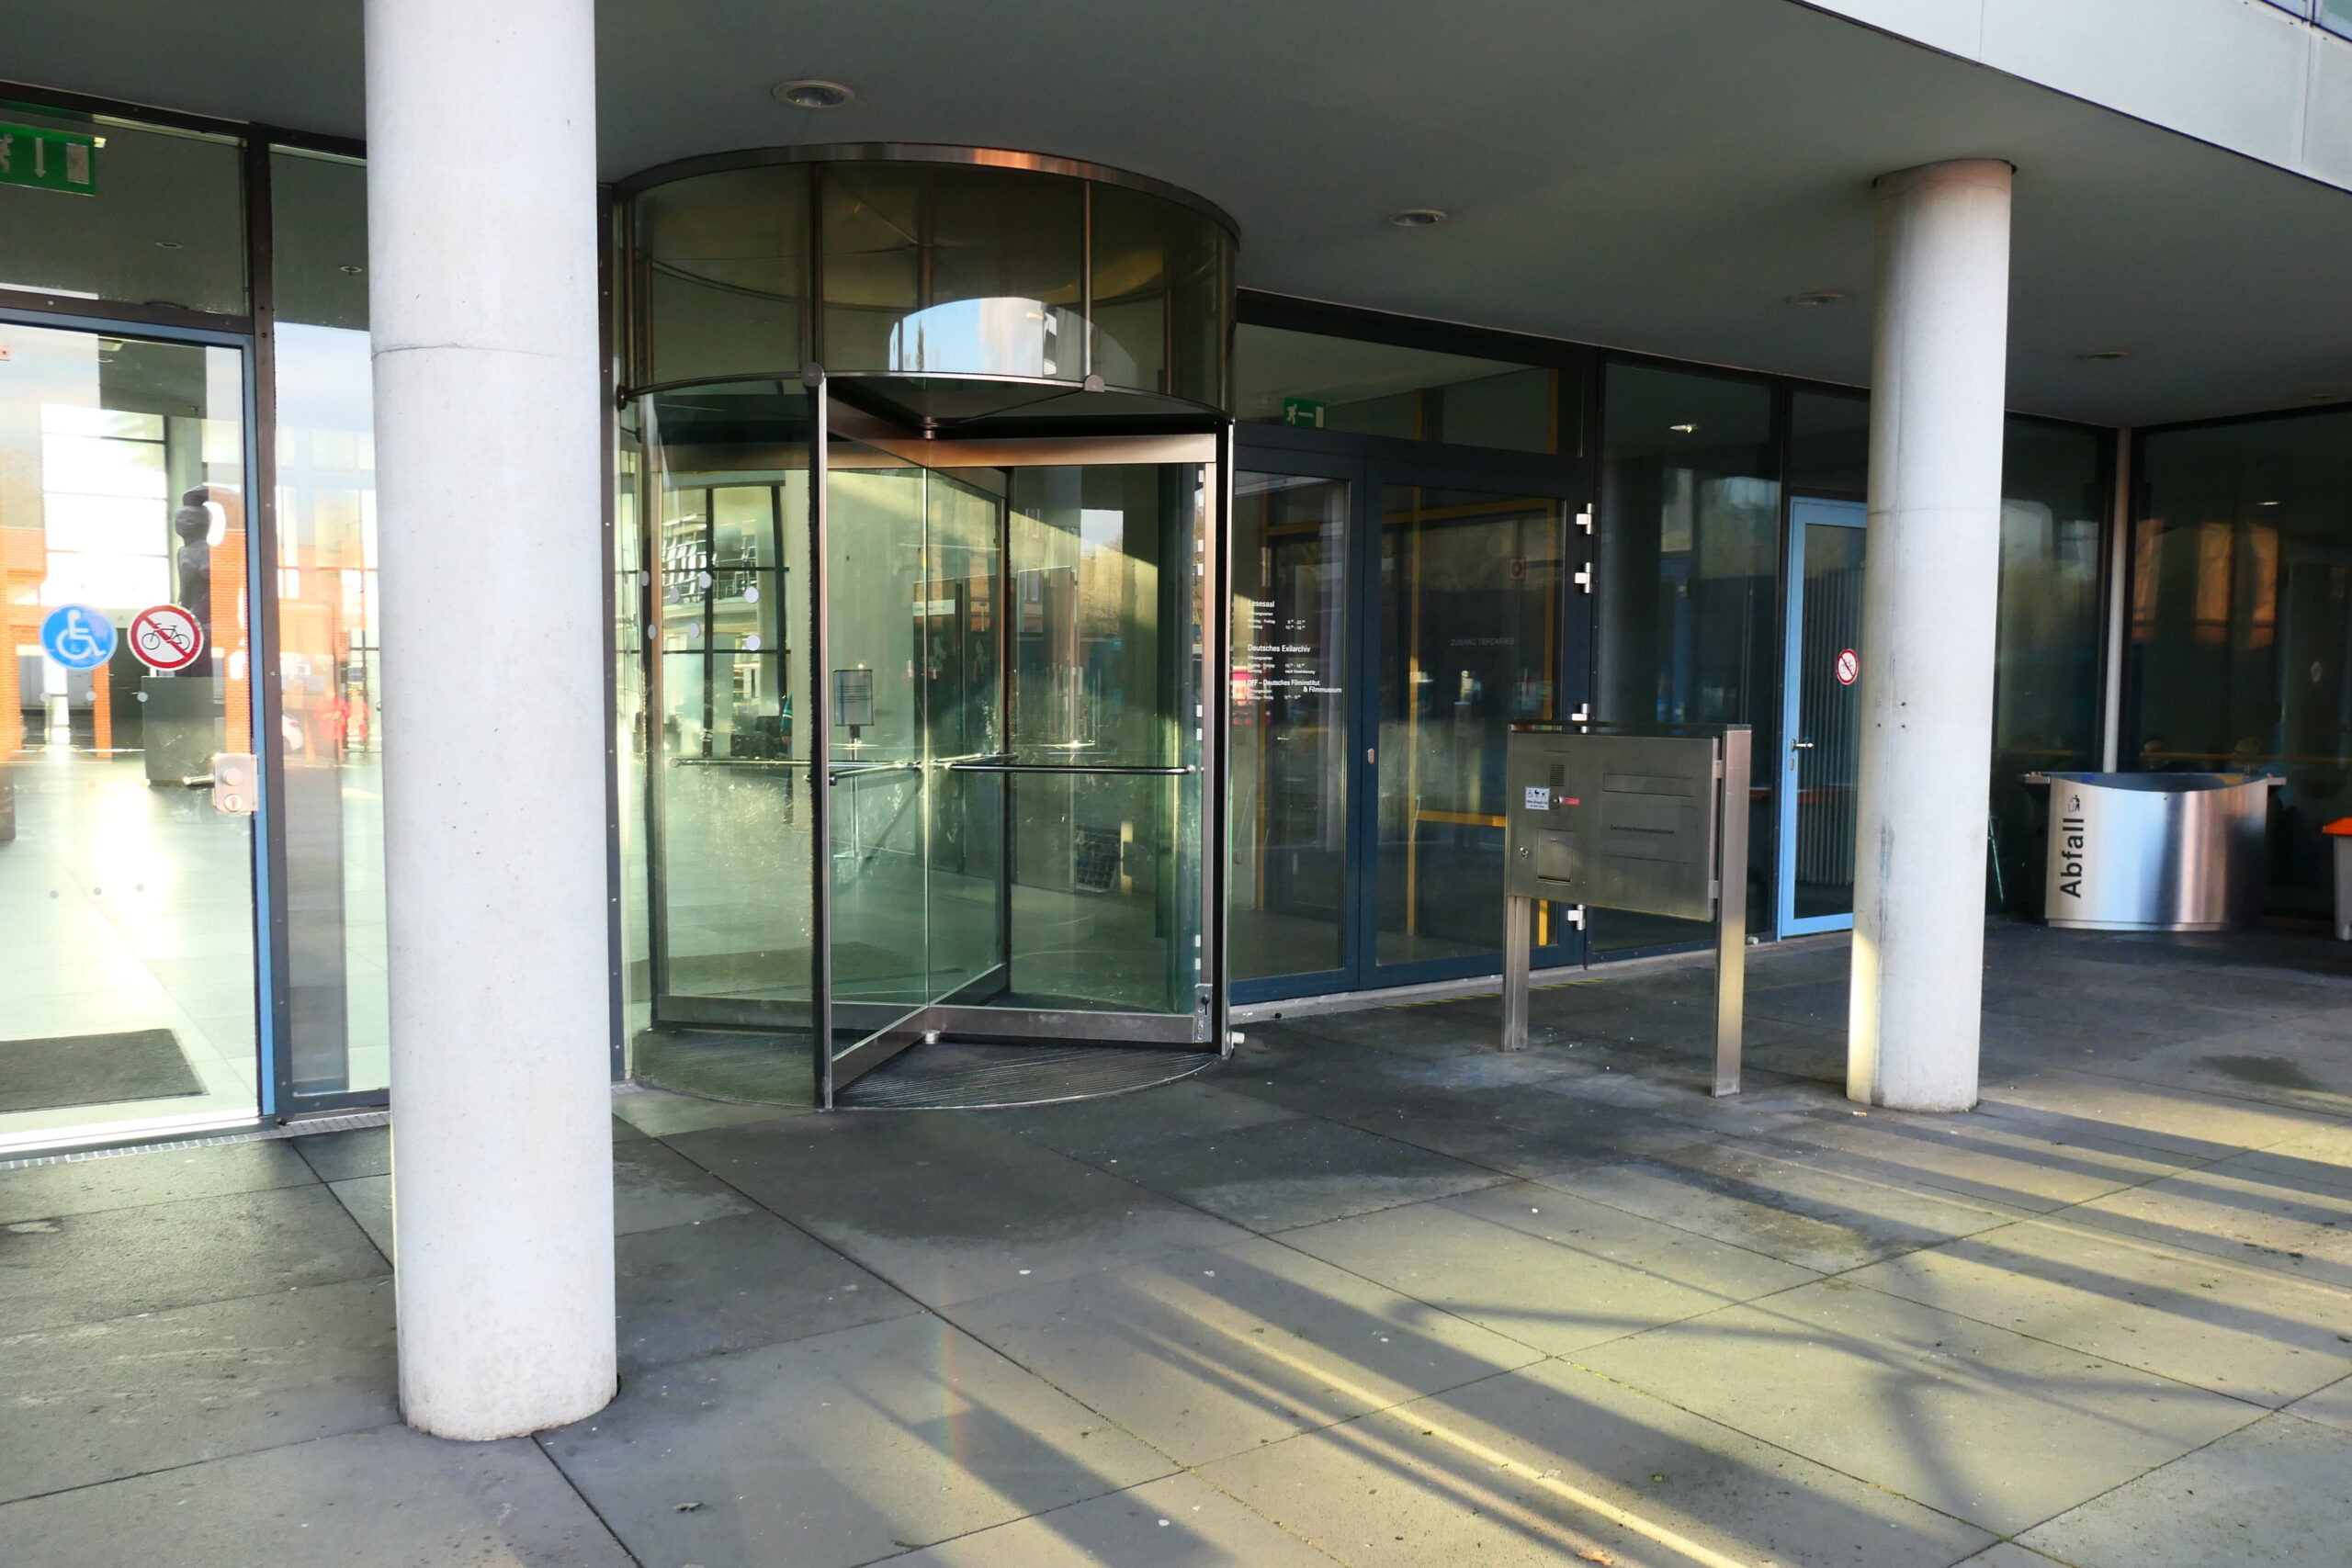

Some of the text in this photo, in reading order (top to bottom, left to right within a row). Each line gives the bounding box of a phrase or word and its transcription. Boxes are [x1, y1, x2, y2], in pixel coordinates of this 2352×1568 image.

[1248, 600, 1275, 608] Lesesaal
[1248, 644, 1311, 653] Deutsches Exilarchiv
[2059, 818, 2085, 898] Abfall
